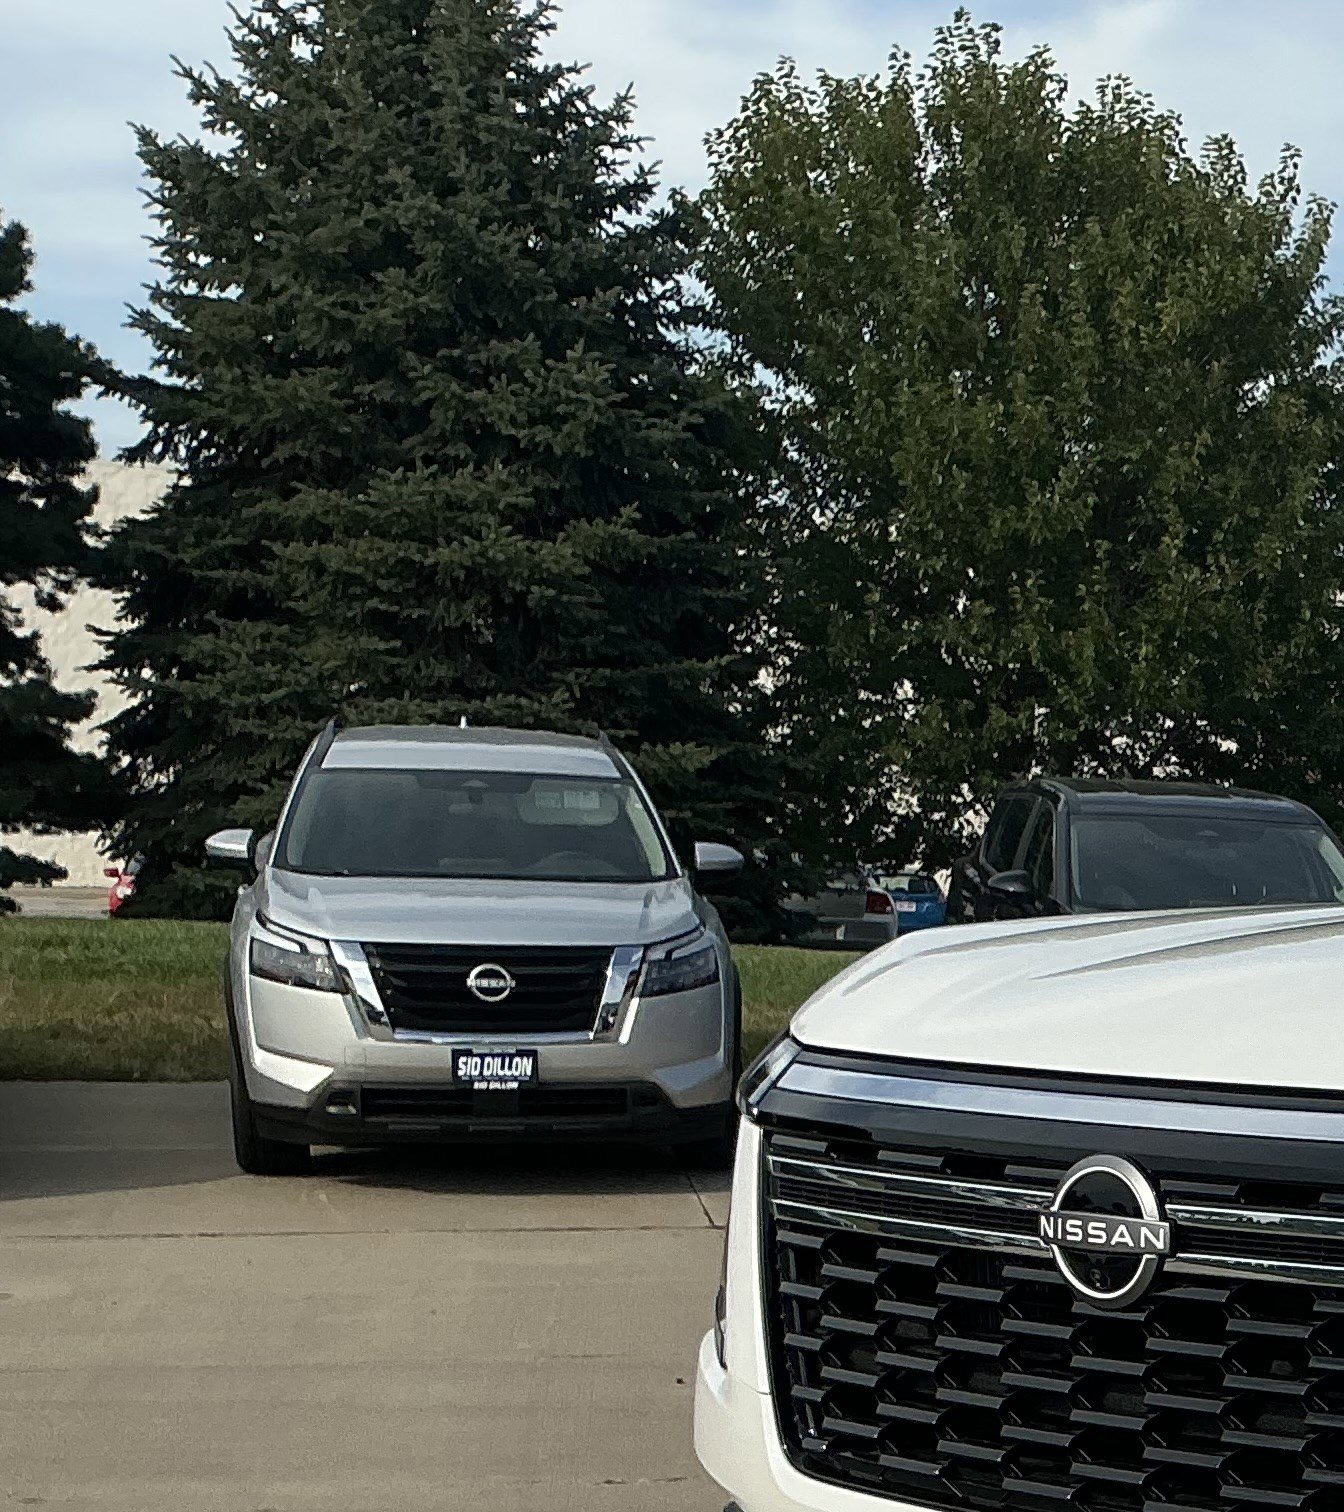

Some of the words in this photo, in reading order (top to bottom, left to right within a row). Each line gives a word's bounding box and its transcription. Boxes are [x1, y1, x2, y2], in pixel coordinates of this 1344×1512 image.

[457, 1056, 481, 1077] SID
[482, 1056, 533, 1077] DILLON
[1039, 1214, 1165, 1250] NISSAN
